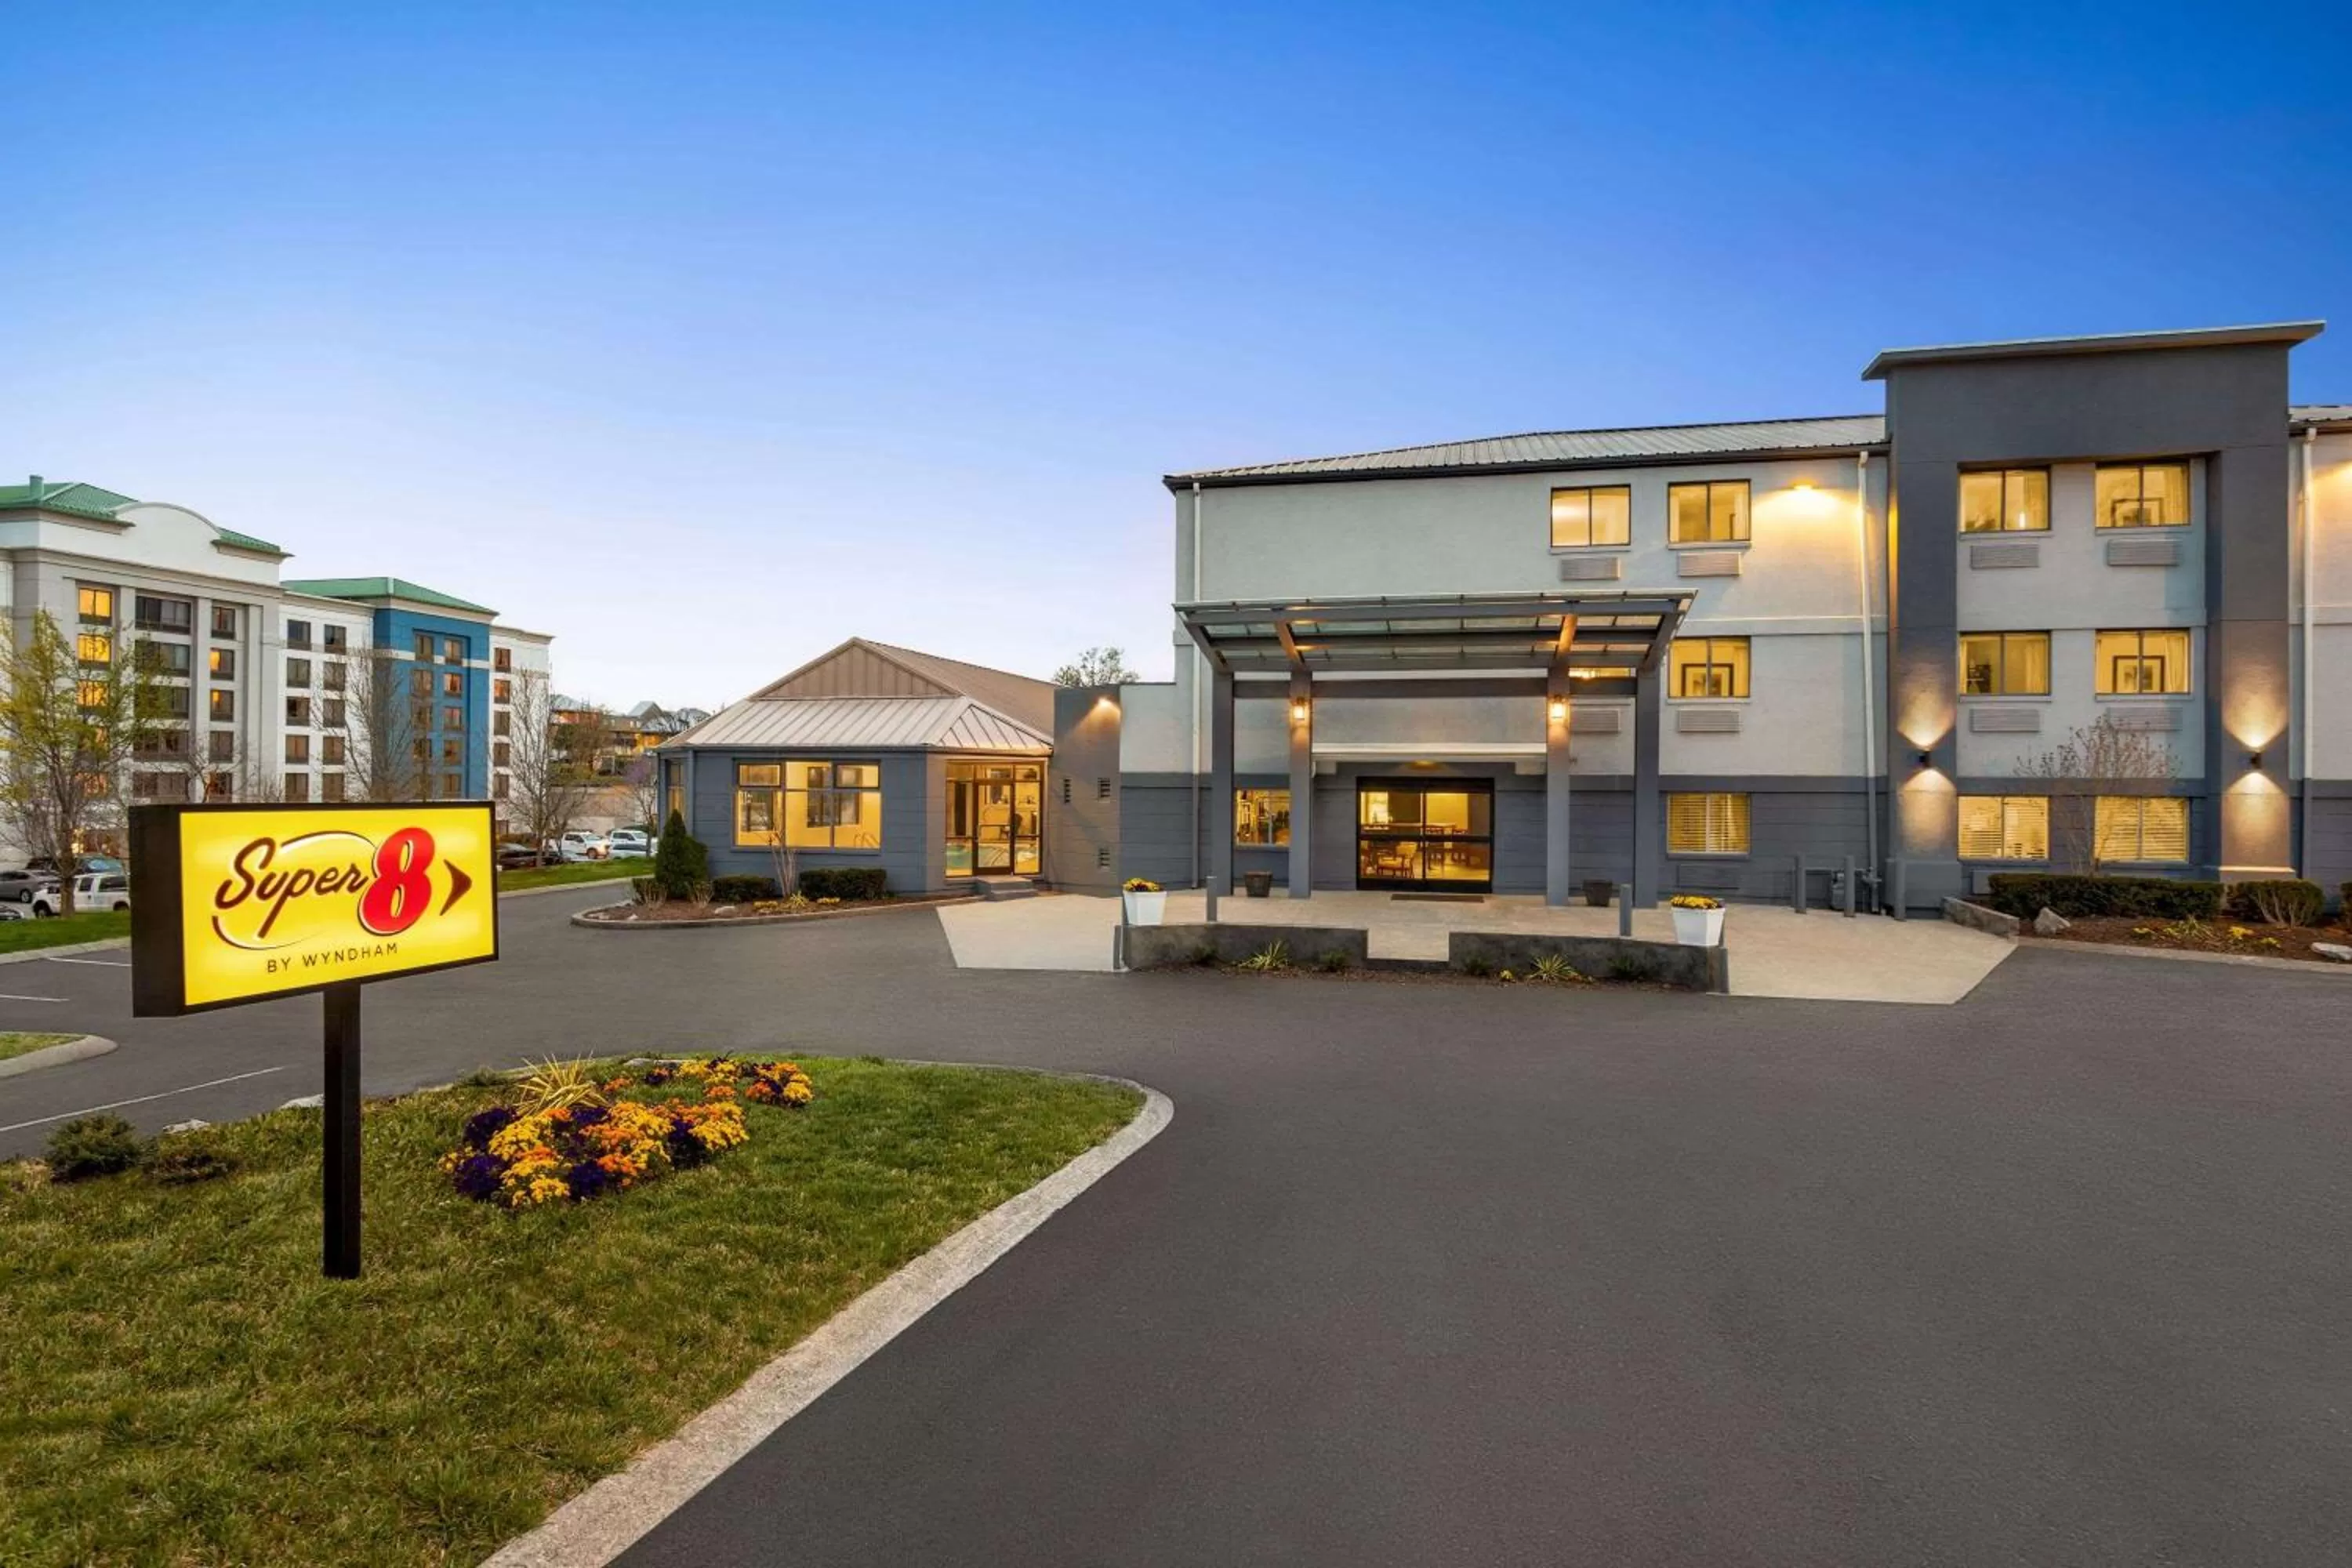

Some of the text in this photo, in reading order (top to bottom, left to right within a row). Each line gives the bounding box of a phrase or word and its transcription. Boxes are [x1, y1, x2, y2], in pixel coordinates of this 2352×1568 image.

[215, 826, 436, 938] Super 8
[267, 942, 398, 973] BY WYNDHAM
